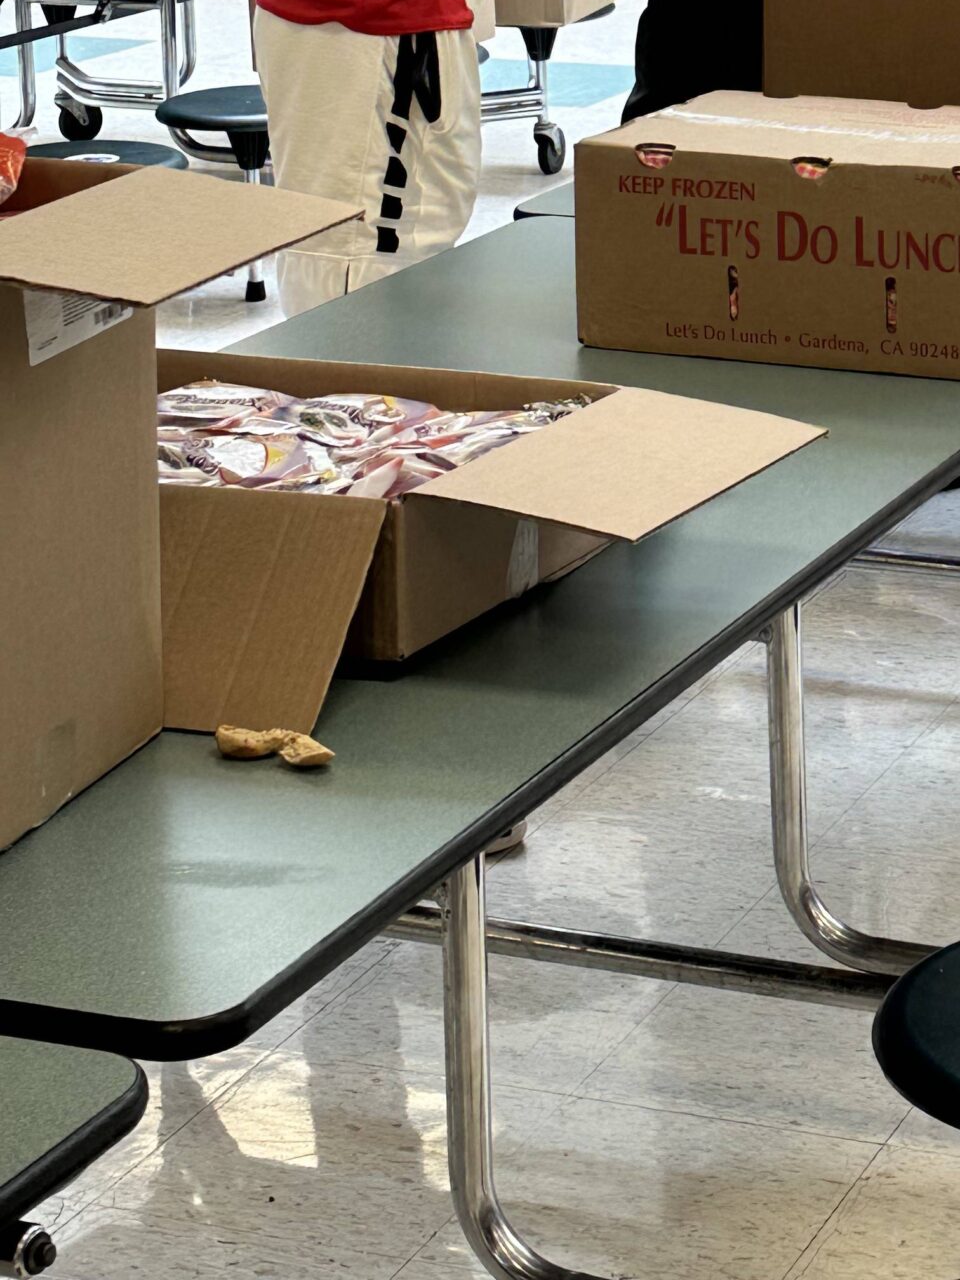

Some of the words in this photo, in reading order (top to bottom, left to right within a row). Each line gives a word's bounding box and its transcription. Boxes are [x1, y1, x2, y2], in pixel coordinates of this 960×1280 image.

[618, 175, 665, 195] KEEP
[671, 177, 757, 201] FROZEN
[665, 322, 699, 340] Let's
[703, 324, 726, 341] Do
[731, 327, 778, 345] Lunch
[798, 332, 870, 355] Gardena,
[880, 339, 904, 356] CA
[909, 341, 960, 360] 90248
